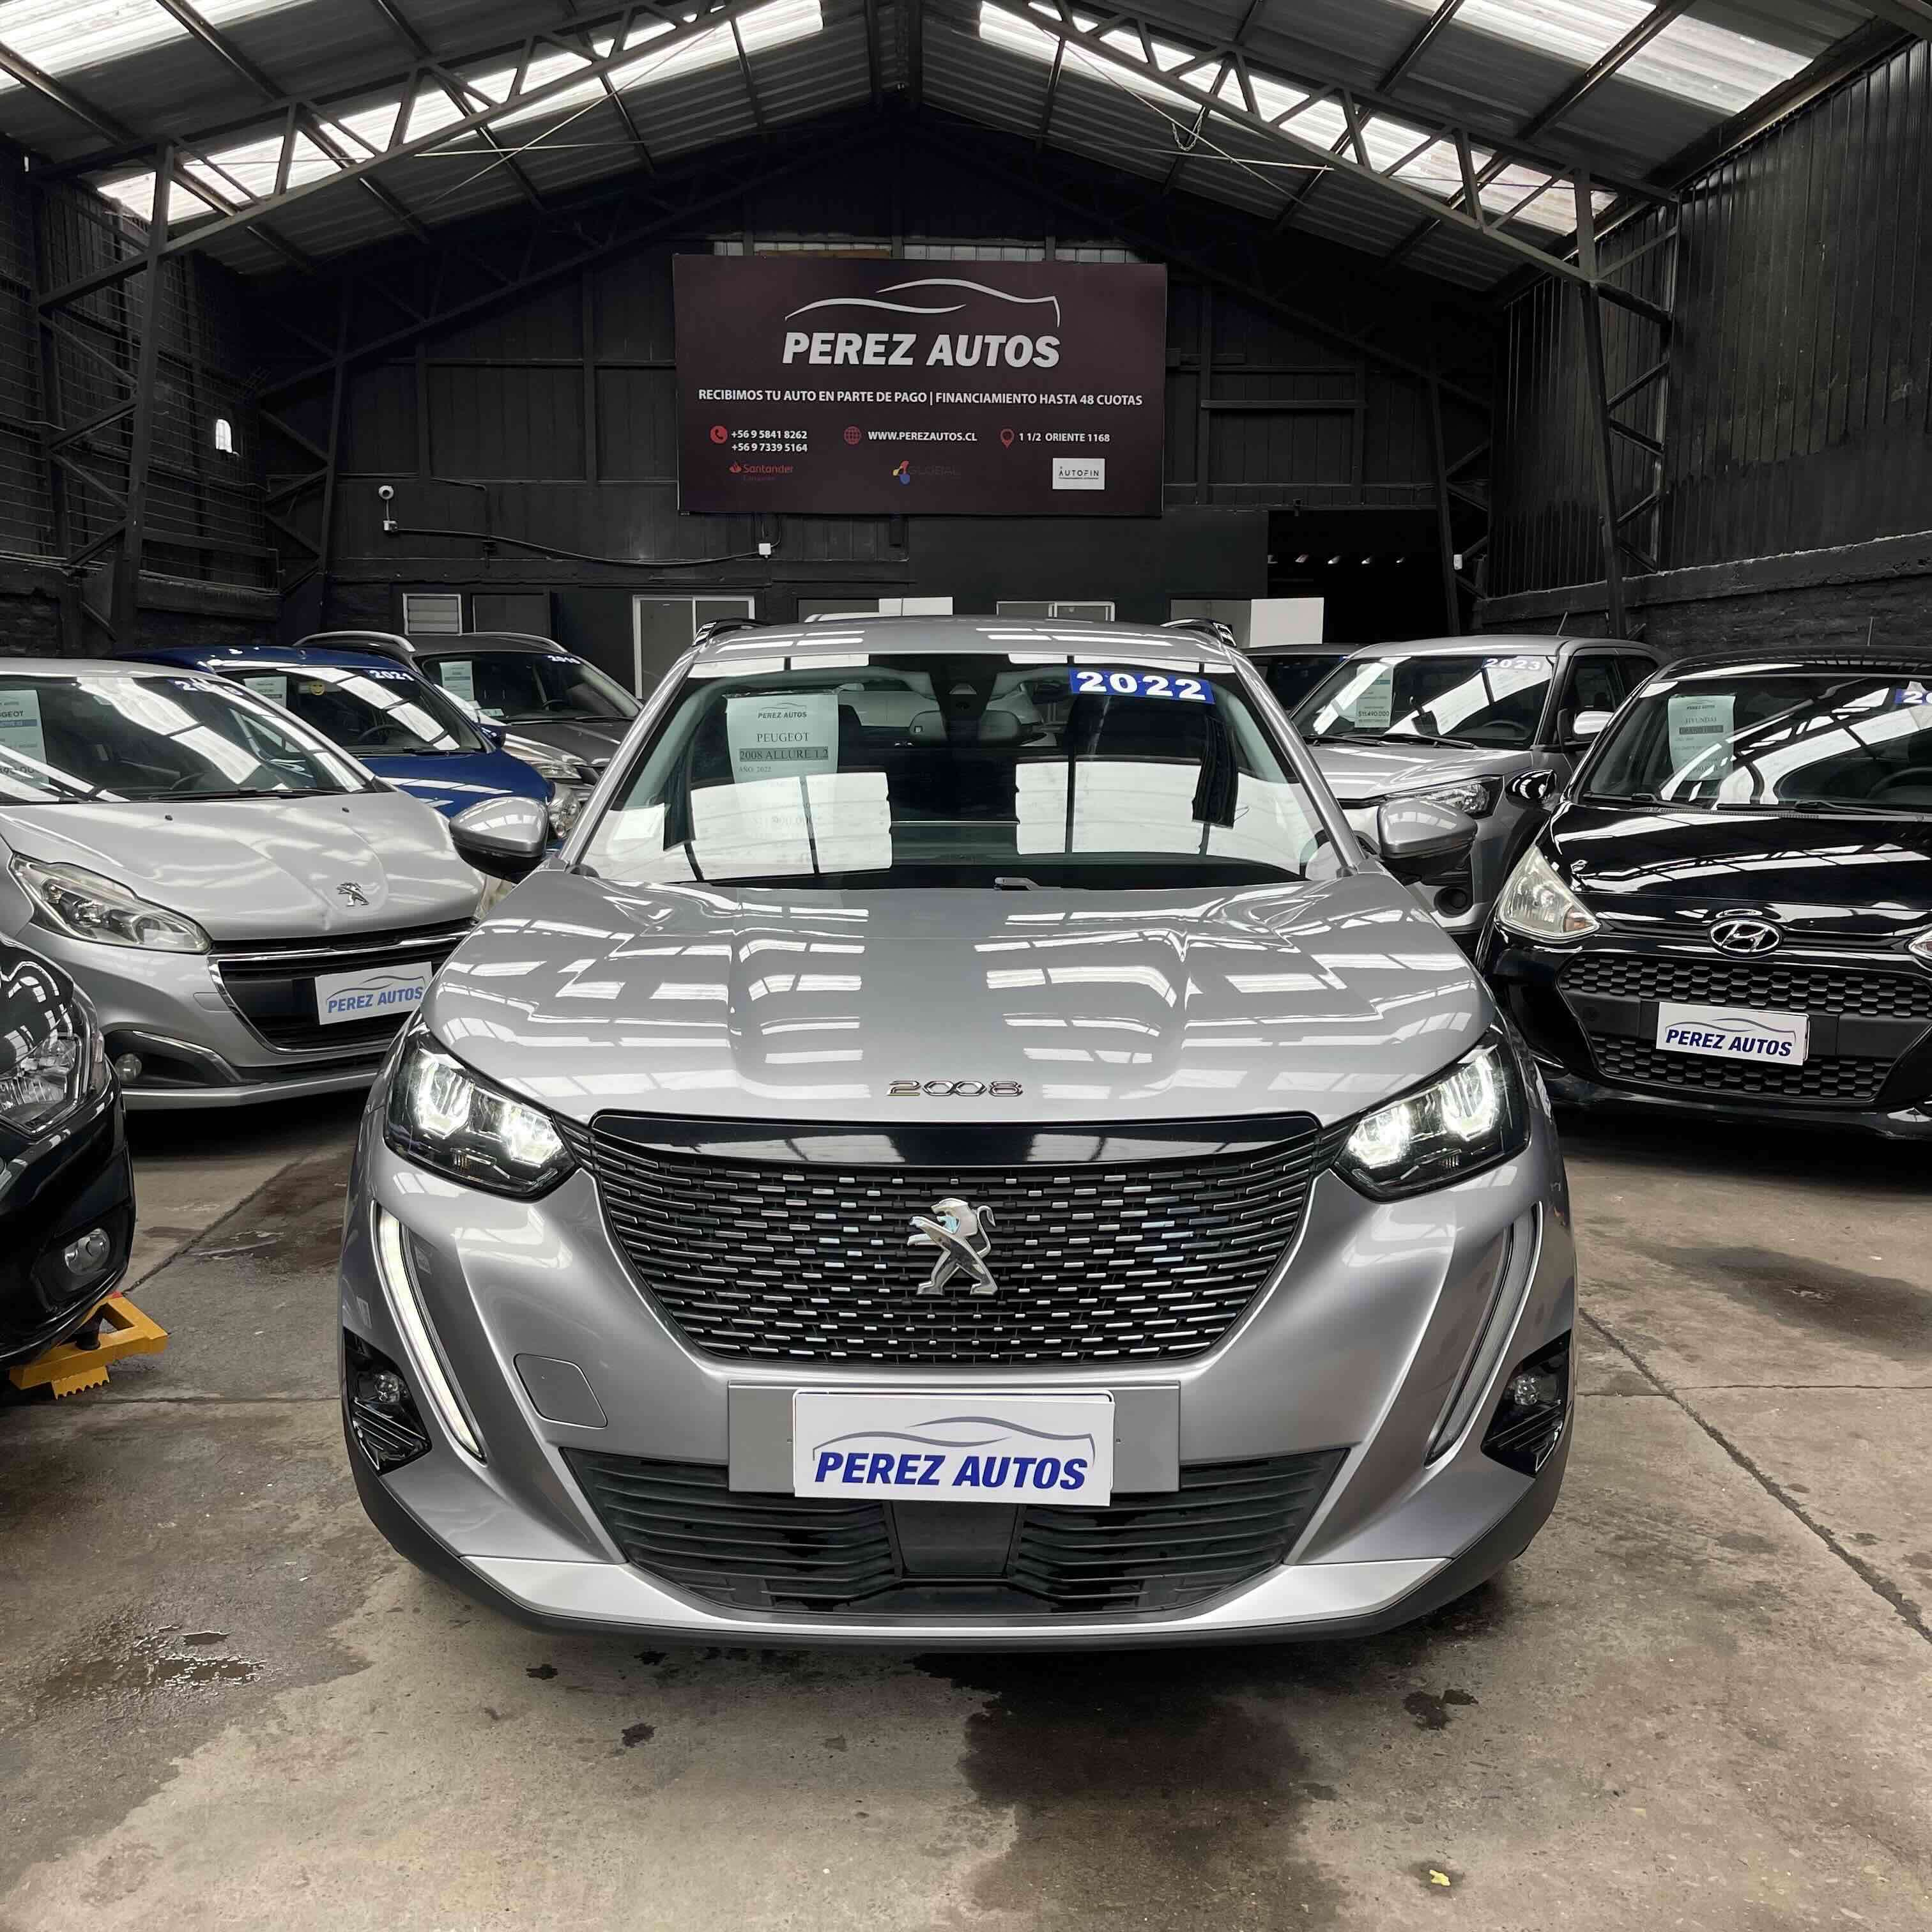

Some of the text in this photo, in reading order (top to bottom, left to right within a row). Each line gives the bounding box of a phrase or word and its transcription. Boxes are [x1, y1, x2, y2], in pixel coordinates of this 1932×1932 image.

[782, 332, 1061, 368] PEREZ AUTOS
[698, 389, 763, 401] RECIBIMOS
[765, 390, 781, 401] TU
[784, 390, 816, 401] AUTO
[819, 391, 834, 402] EN
[837, 392, 874, 402] PARTE
[876, 392, 892, 402] DE
[895, 392, 927, 403] PAGO
[936, 392, 1038, 404] FINANCIAMIENTO
[1039, 394, 1078, 405] HASTA
[1080, 394, 1094, 405] 48
[1096, 395, 1143, 406] CUOTAS
[731, 430, 808, 439] +56 9 5841 8262
[868, 431, 977, 442] WWW.PEREZAUTOS.CL
[1018, 433, 1110, 443] 1 1/2 ORIENTE 1168
[732, 443, 808, 452] +56 9 7339 5164
[1484, 658, 1541, 670] 2023
[369, 670, 415, 681] 2021
[1077, 671, 1206, 701] 2022
[756, 732, 809, 743] PEUGEOT
[739, 751, 763, 760] 2008
[765, 749, 811, 760] ALLURE
[328, 986, 424, 1013] PEREZ AUTOS
[1665, 1029, 1793, 1057] PEREZ AUTOS
[886, 1080, 1023, 1097] 2008
[815, 1451, 1088, 1491] PEREZ AUTOS
